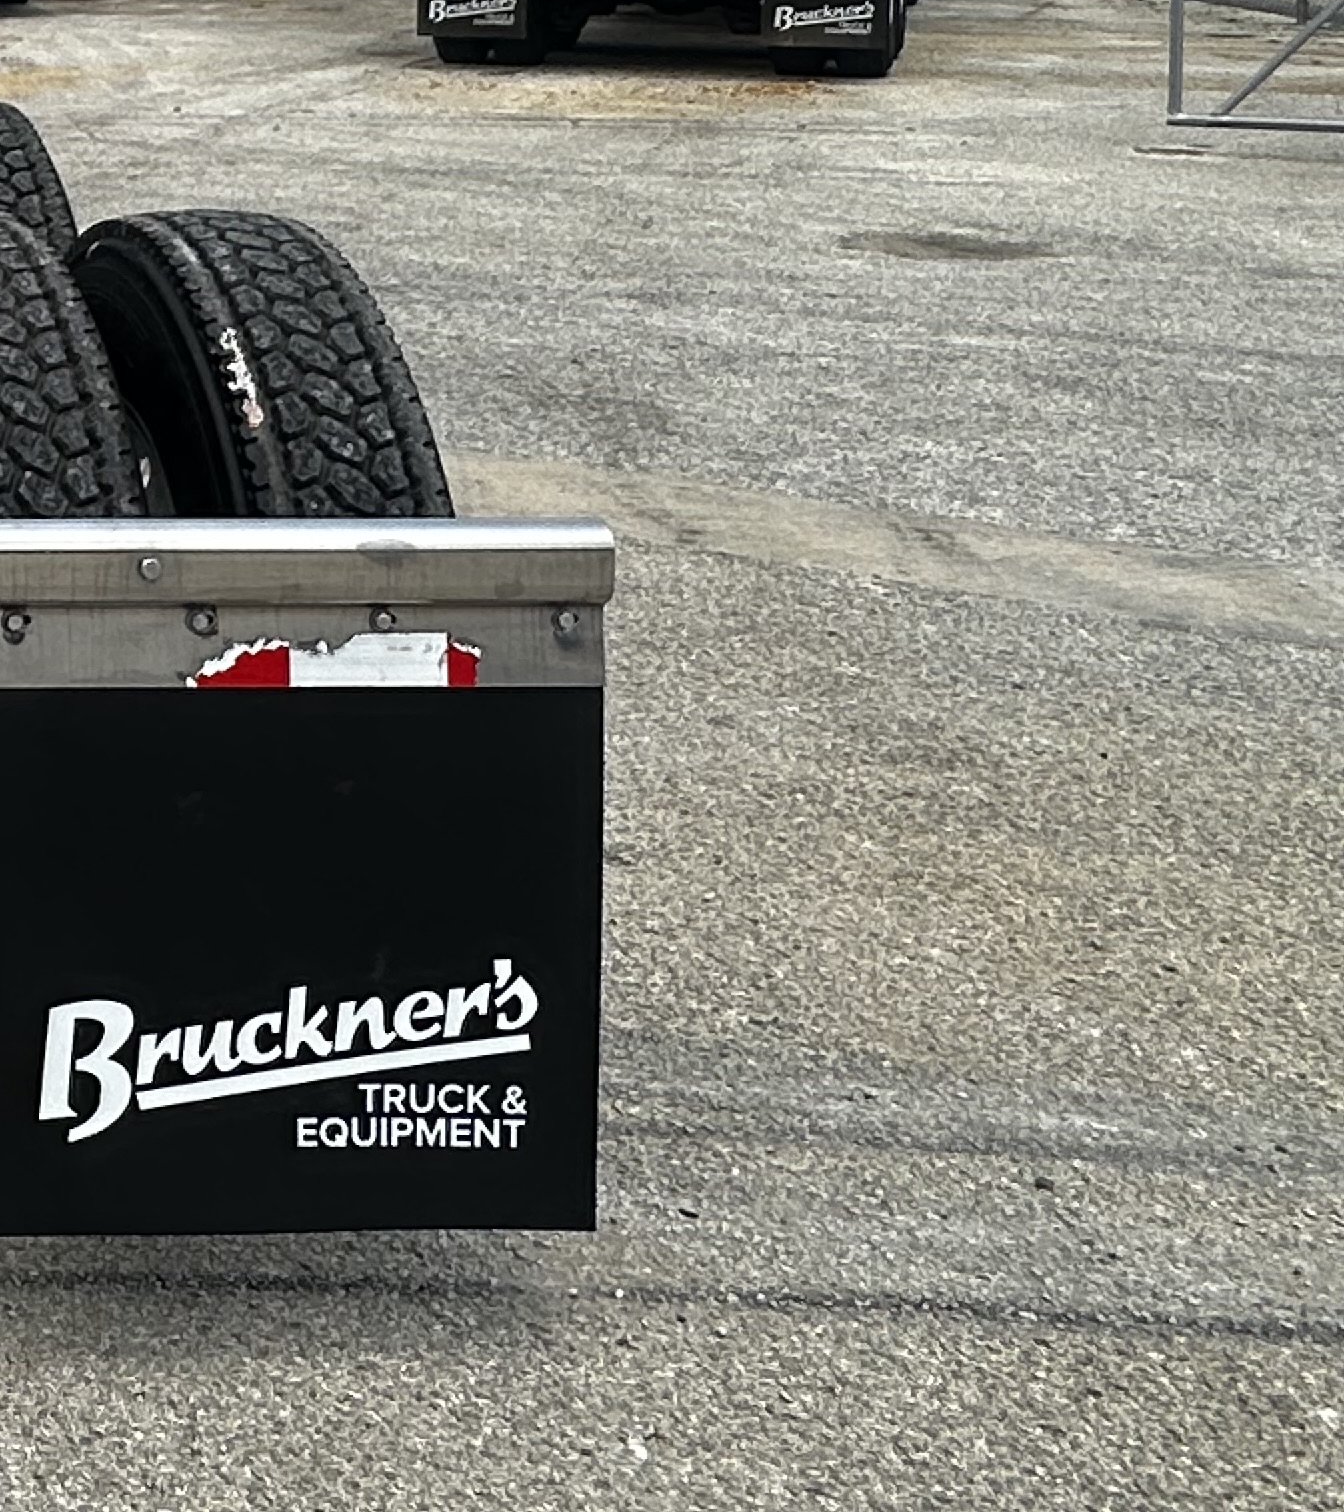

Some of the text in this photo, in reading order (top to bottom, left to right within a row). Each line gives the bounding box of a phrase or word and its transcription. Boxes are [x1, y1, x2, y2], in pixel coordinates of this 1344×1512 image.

[38, 958, 539, 1143] Bruckner's
[358, 1083, 528, 1115] TRUCK &
[296, 1116, 527, 1149] EQUIPMENT
